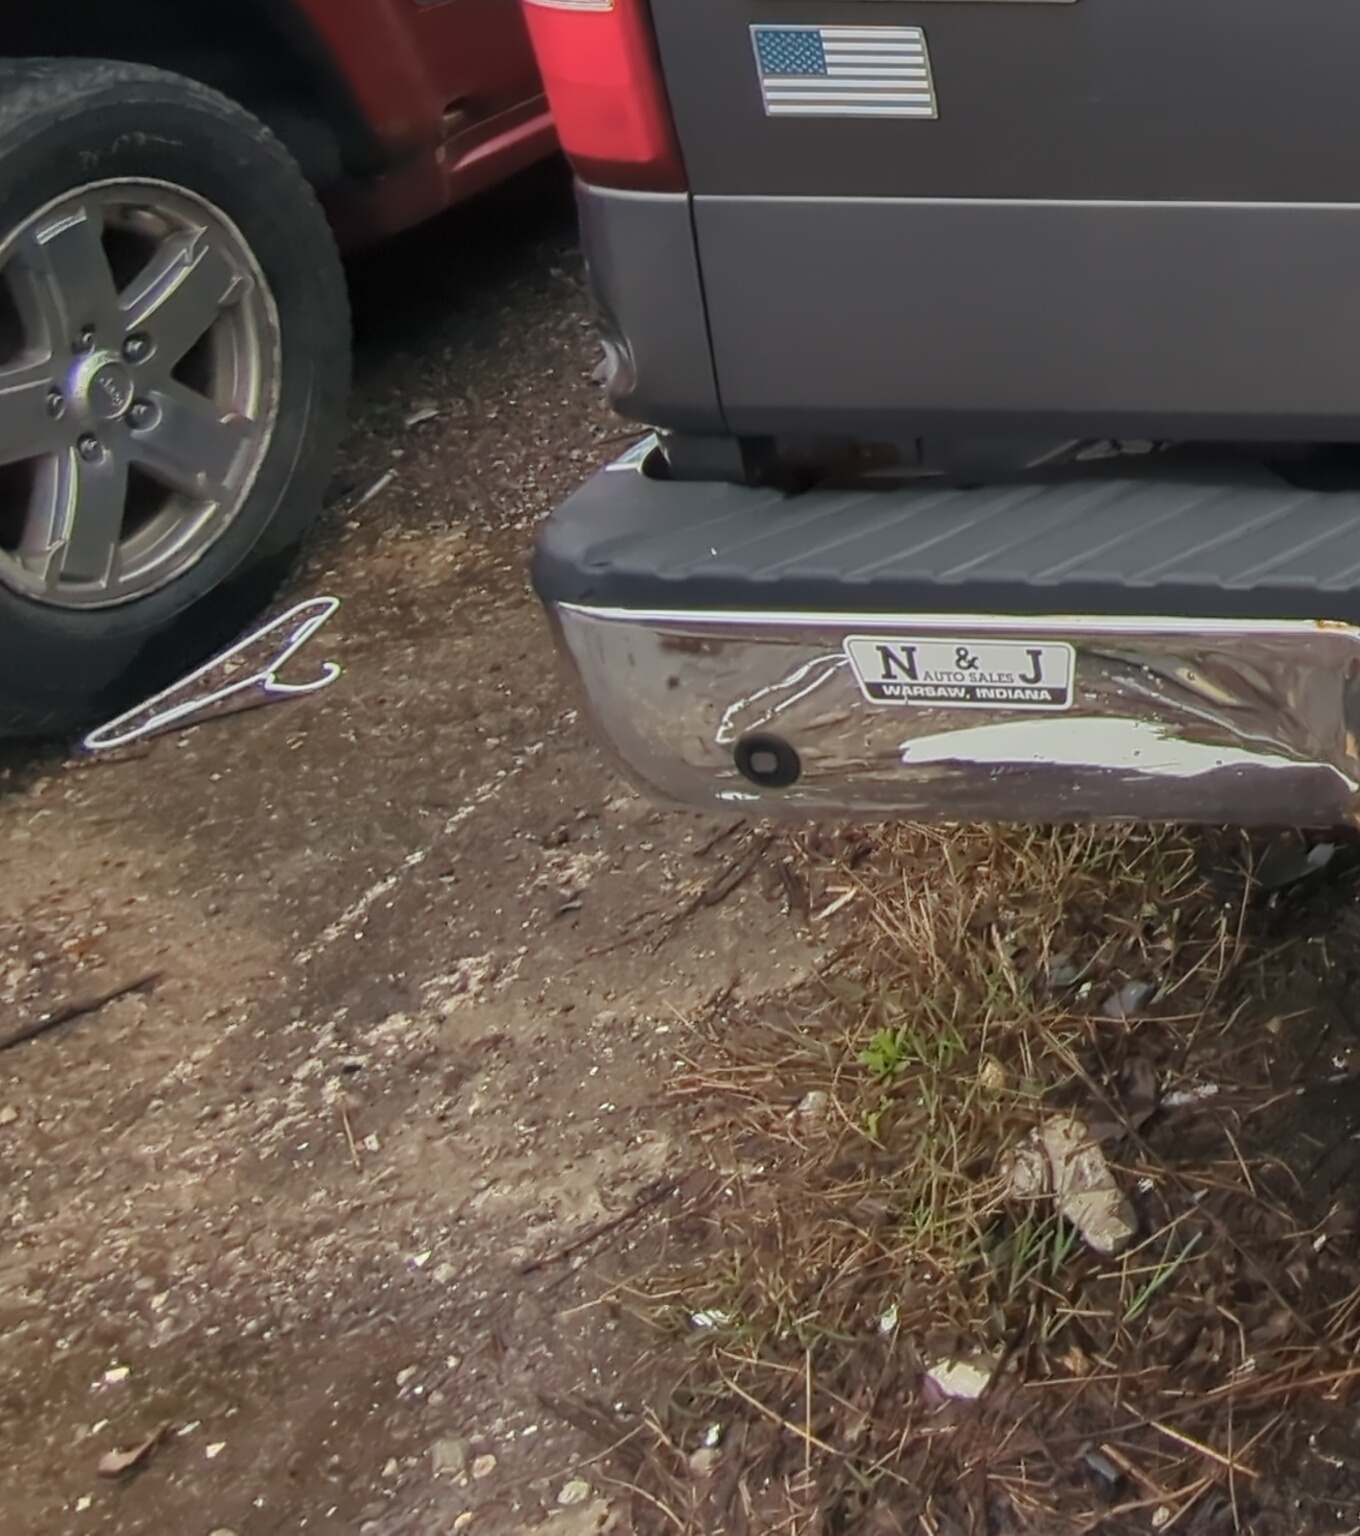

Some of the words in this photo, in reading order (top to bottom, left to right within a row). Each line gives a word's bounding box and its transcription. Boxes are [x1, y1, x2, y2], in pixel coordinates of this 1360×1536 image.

[875, 645, 918, 681] N
[955, 647, 979, 670] &
[1019, 649, 1043, 685] J
[922, 671, 965, 683] AUTO
[969, 671, 1015, 684] SALES
[882, 685, 971, 699] WARSAW,
[976, 687, 1052, 701] INDIANA
